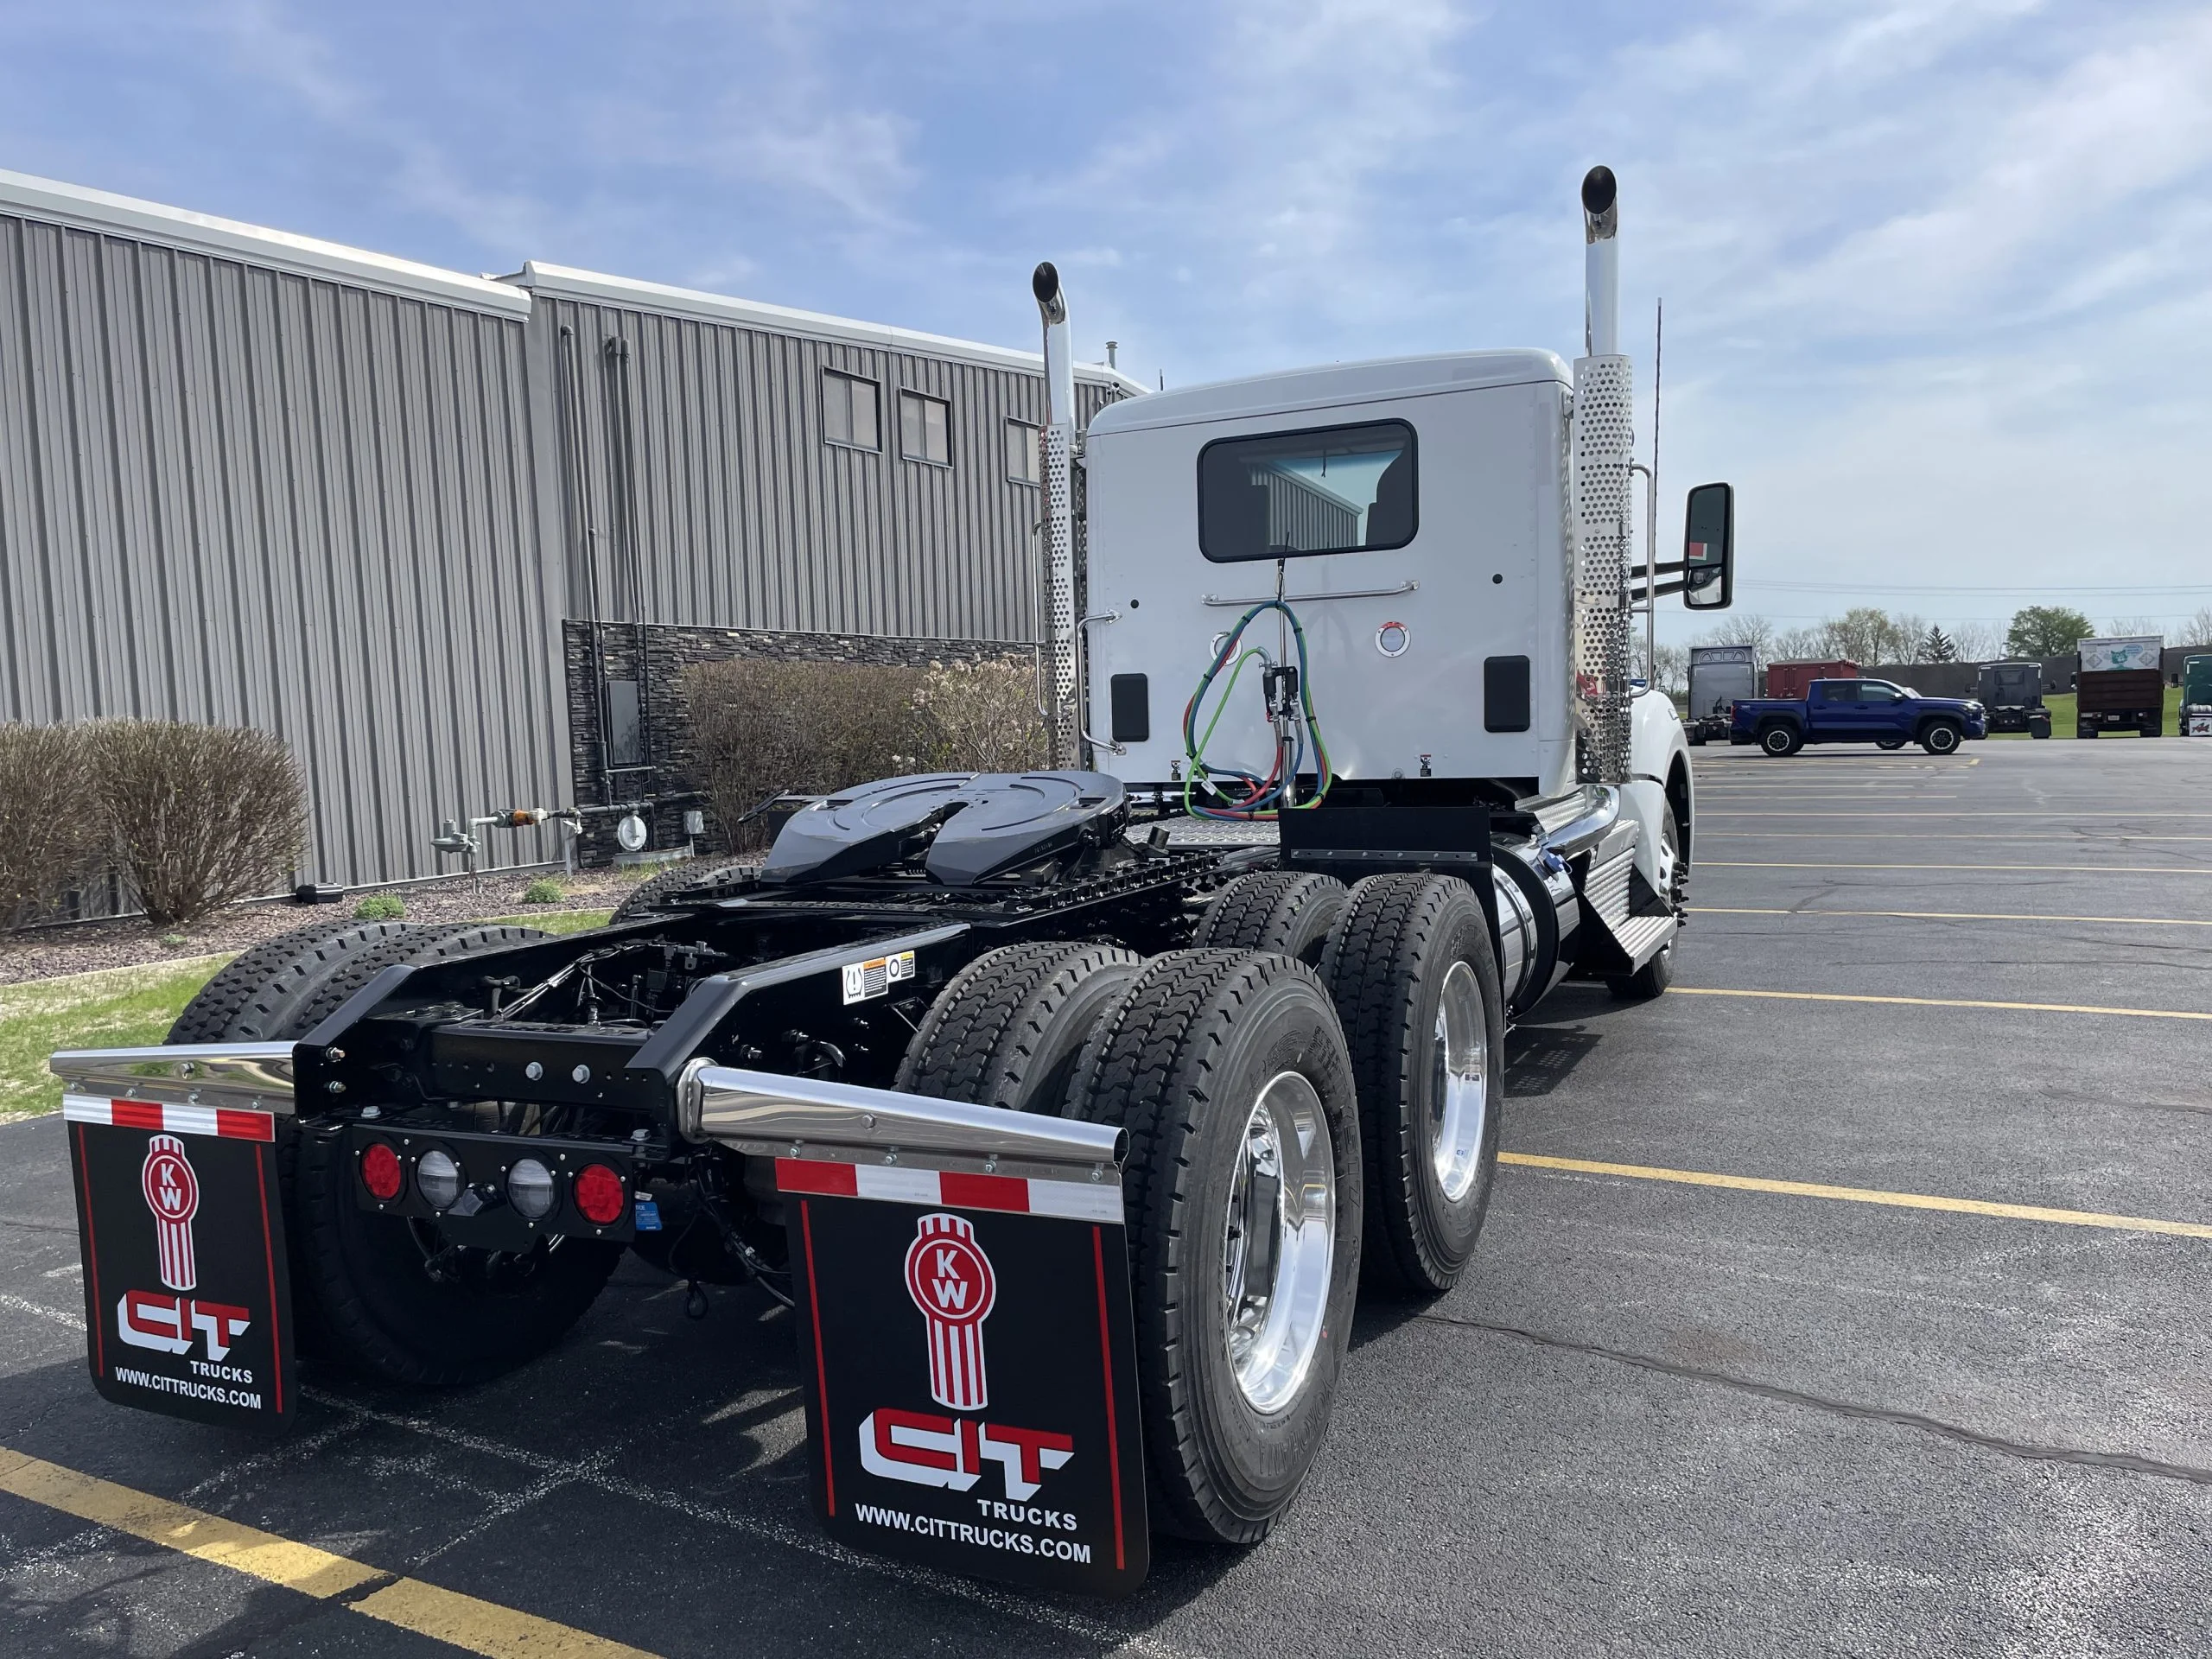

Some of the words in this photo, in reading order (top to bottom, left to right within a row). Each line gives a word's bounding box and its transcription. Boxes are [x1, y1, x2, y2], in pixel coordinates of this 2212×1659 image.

[161, 1162, 177, 1187] K
[158, 1186, 182, 1211] W
[936, 1249, 961, 1280] K
[931, 1278, 969, 1310] W
[118, 1291, 251, 1361] CIT
[115, 1366, 262, 1409] WWW.CITTRUCKS.COM
[189, 1360, 253, 1384] TRUCKS
[859, 1408, 1074, 1502] CIT
[976, 1498, 1077, 1531] TRUCKS
[855, 1503, 1091, 1564] WWW.CITTRUCKS.COM
